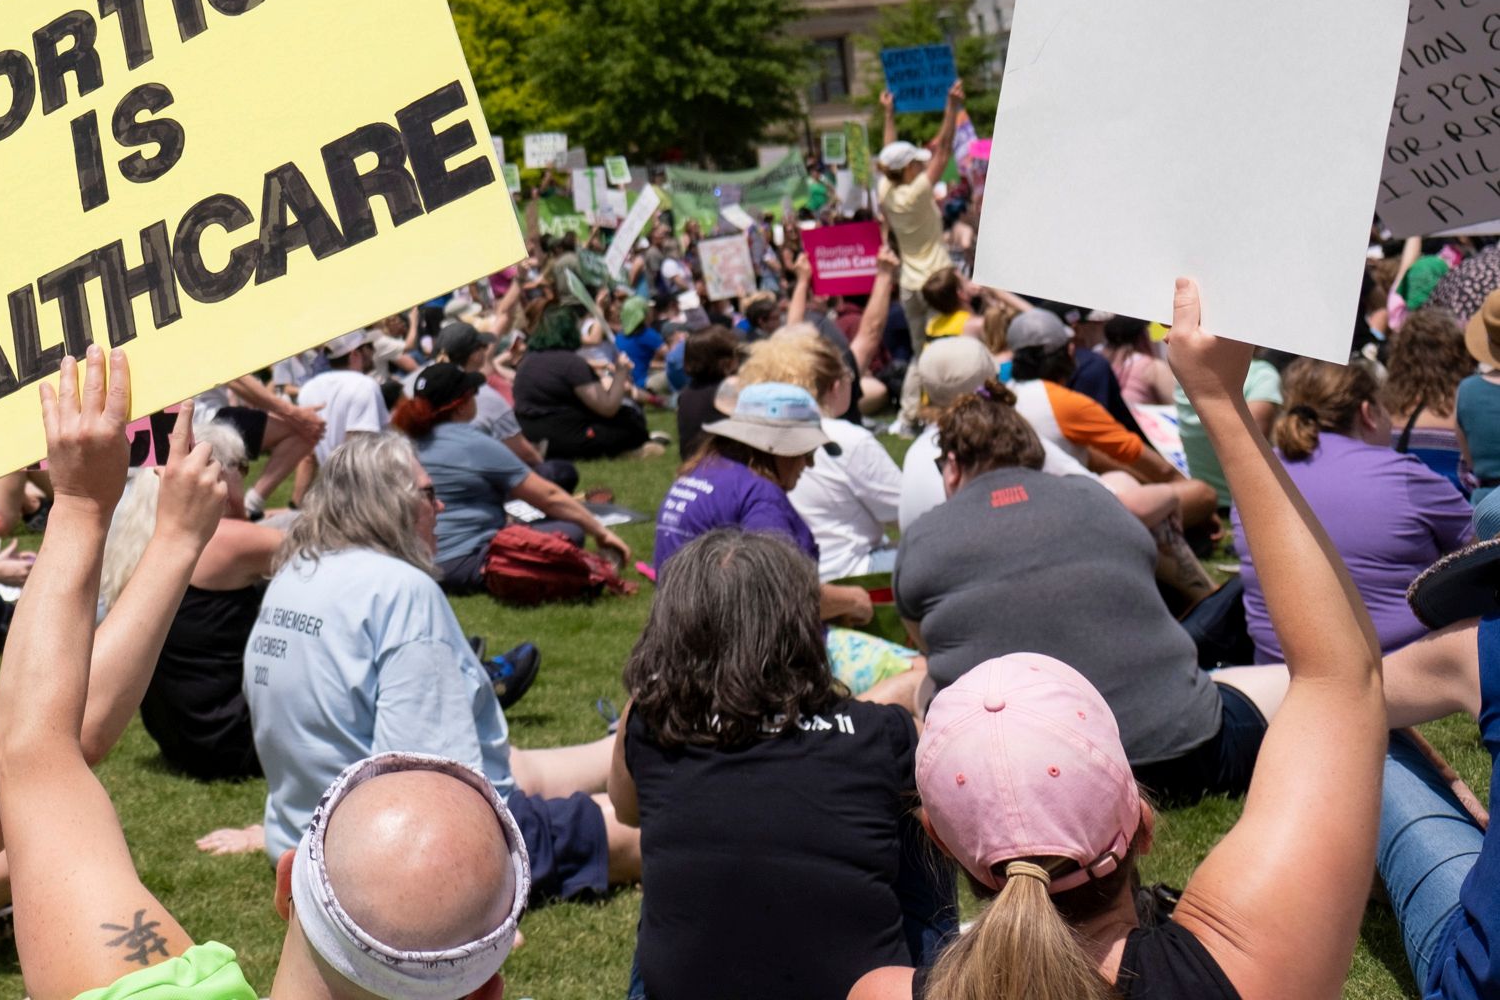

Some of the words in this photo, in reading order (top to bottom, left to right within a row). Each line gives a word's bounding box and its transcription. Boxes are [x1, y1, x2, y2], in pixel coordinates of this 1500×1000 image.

[1400, 30, 1468, 77] ION
[70, 81, 185, 213] IS
[1410, 149, 1499, 189] WILL
[816, 256, 852, 271] Health
[272, 606, 324, 638] REMEMBER
